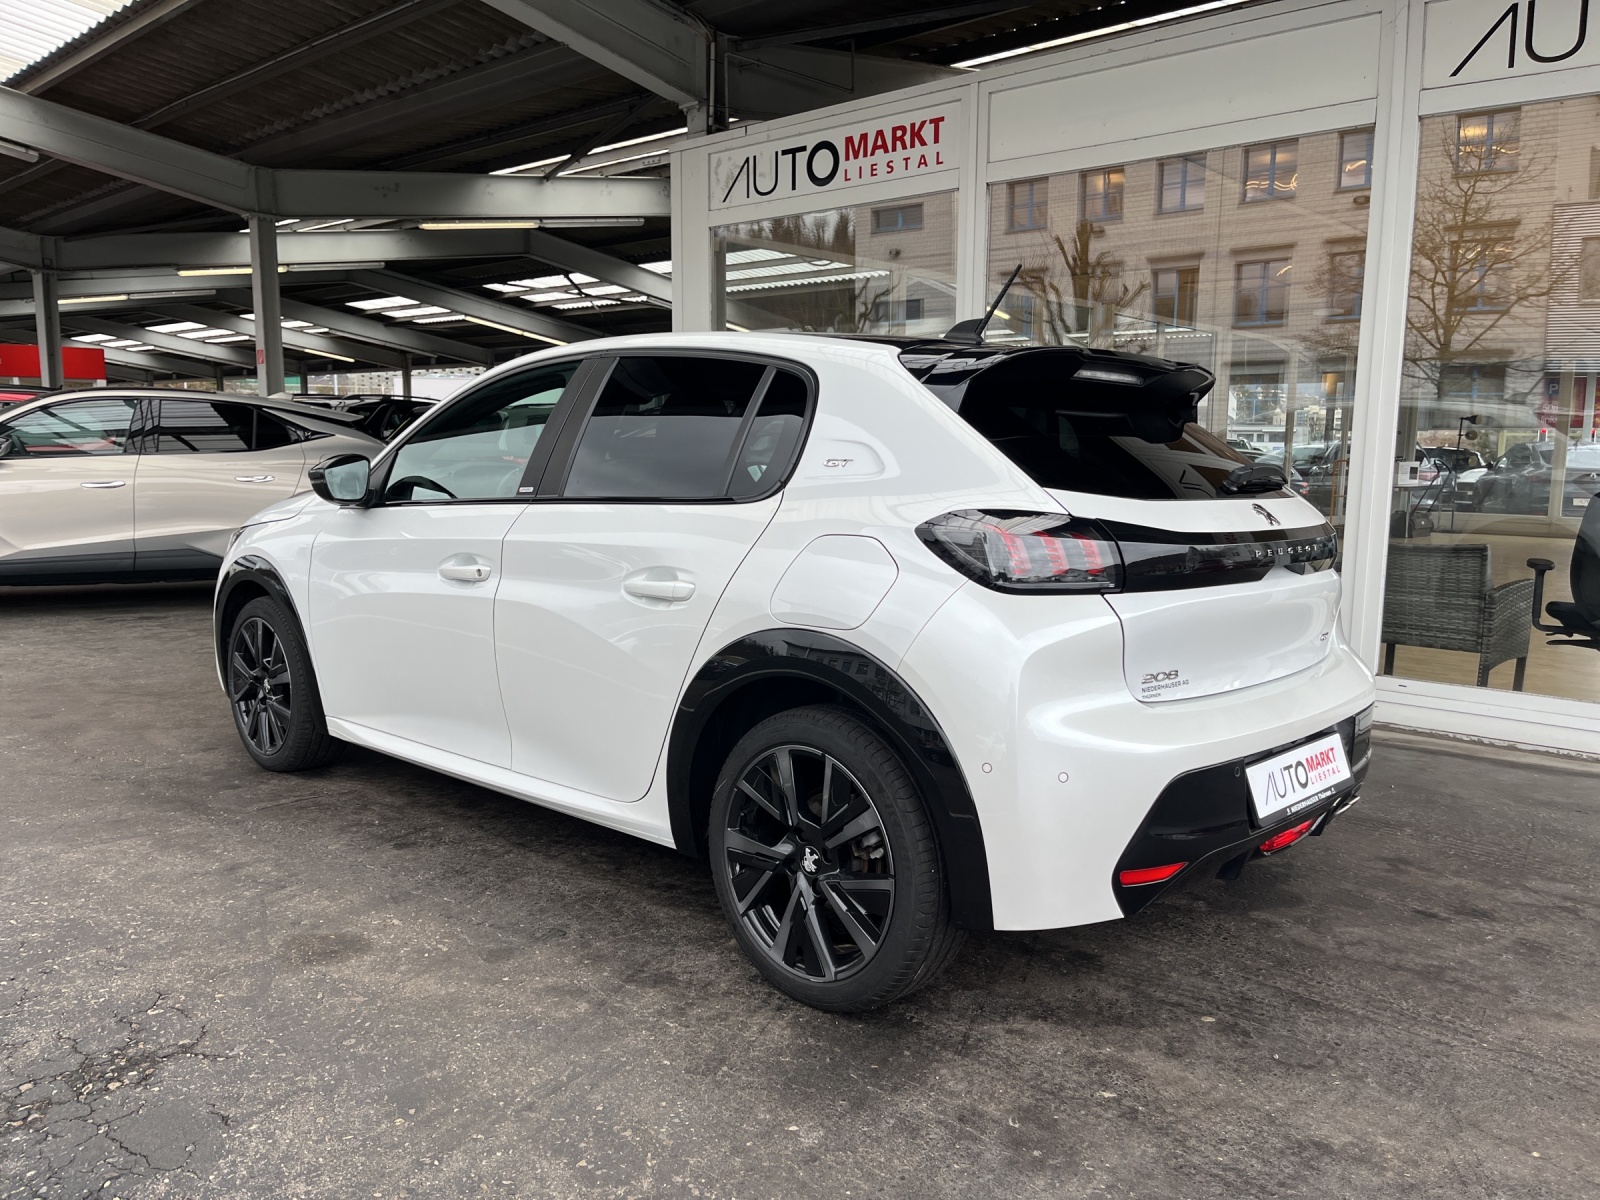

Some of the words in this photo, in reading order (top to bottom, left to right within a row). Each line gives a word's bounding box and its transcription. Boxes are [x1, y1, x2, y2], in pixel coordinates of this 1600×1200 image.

[722, 140, 840, 203] AUTO
[844, 116, 945, 162] MARKT
[844, 151, 944, 182] LIESTAL
[823, 458, 854, 468] GT
[1255, 543, 1318, 558] PEUGEOT
[1141, 669, 1179, 685] 208
[1141, 680, 1181, 693] NIEDERHAUSER
[1265, 760, 1309, 806] AUTO
[1305, 747, 1336, 773] MARKT
[1310, 765, 1341, 785] LIESTAL
